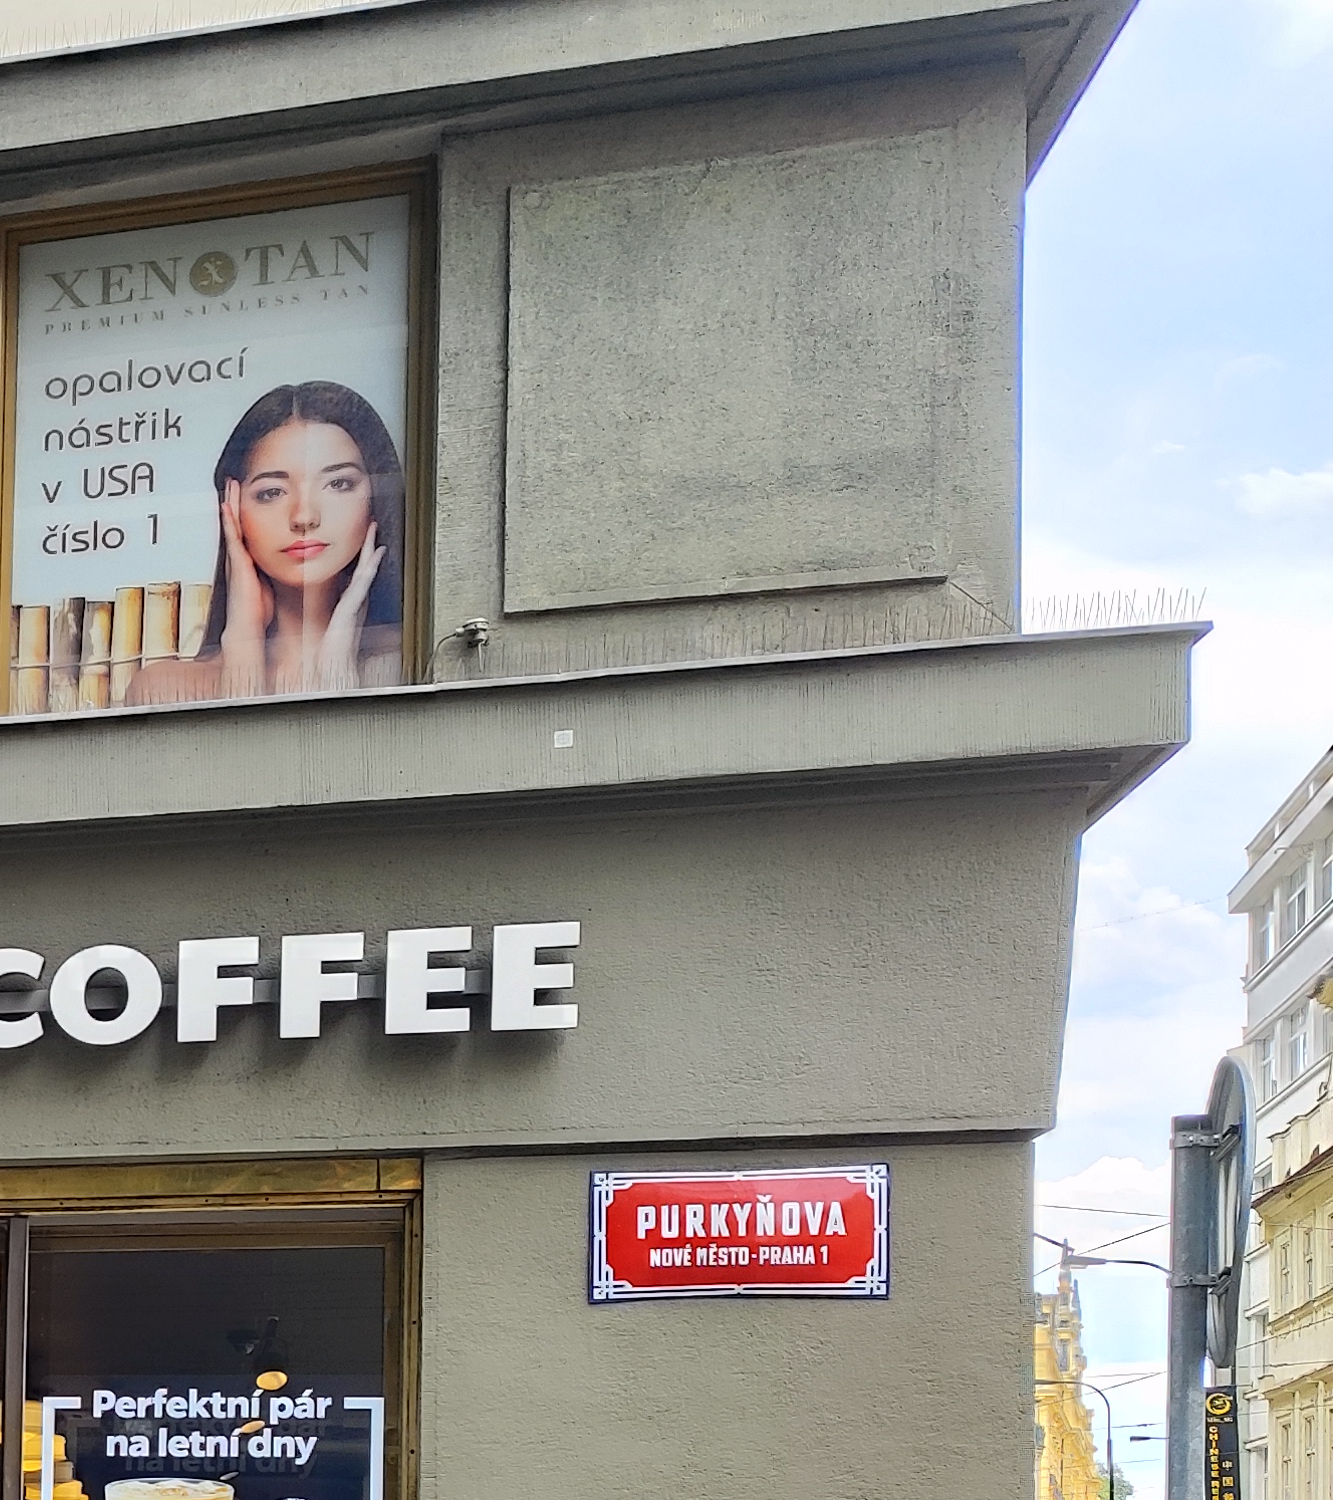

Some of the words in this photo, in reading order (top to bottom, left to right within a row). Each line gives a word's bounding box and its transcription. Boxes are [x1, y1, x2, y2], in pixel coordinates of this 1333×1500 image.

[44, 309, 166, 336] PREMIUM
[183, 292, 301, 317] SUNLESS
[319, 283, 371, 302] TAN
[44, 346, 249, 407] opalovací
[43, 407, 183, 452] nástřik
[41, 480, 63, 504] v
[82, 461, 155, 500] USA
[42, 518, 125, 556] číslo
[146, 513, 159, 546] 1
[636, 1194, 847, 1240] PURKYŇOVA
[649, 1243, 693, 1268] NOVÉ
[820, 1244, 829, 1265] 1
[93, 1388, 265, 1420] Perfektní
[268, 1387, 332, 1426] pár
[106, 1432, 149, 1458] na
[157, 1427, 245, 1459] letní
[246, 1428, 318, 1466] dny
